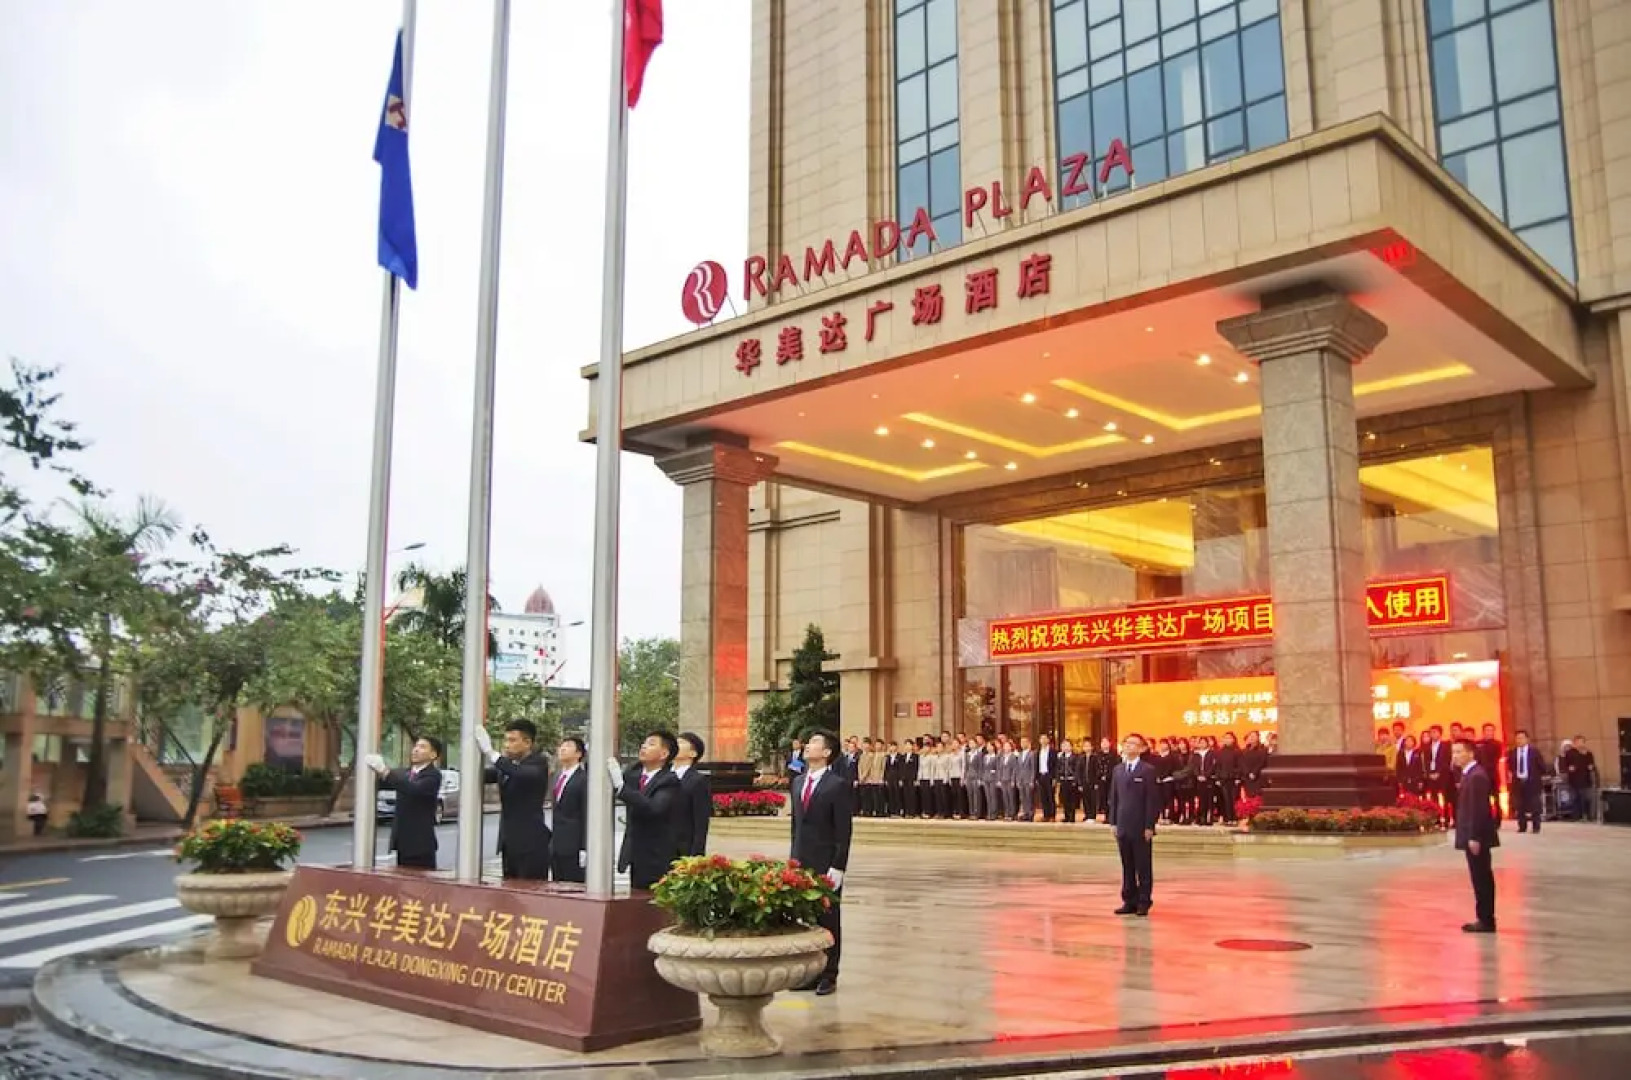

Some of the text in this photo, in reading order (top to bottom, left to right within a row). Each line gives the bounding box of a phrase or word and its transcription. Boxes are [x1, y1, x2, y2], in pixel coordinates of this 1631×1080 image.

[743, 138, 1134, 300] RAMADA PLAZA
[734, 253, 1052, 376] 华美达广场酒店
[991, 603, 1273, 651] 热烈祝贺东兴华美达广场项目
[313, 937, 567, 1003] RAMADA PLAZA DONGXING CITY CENTER
[320, 890, 582, 972] 东兴华美达广场酒店
